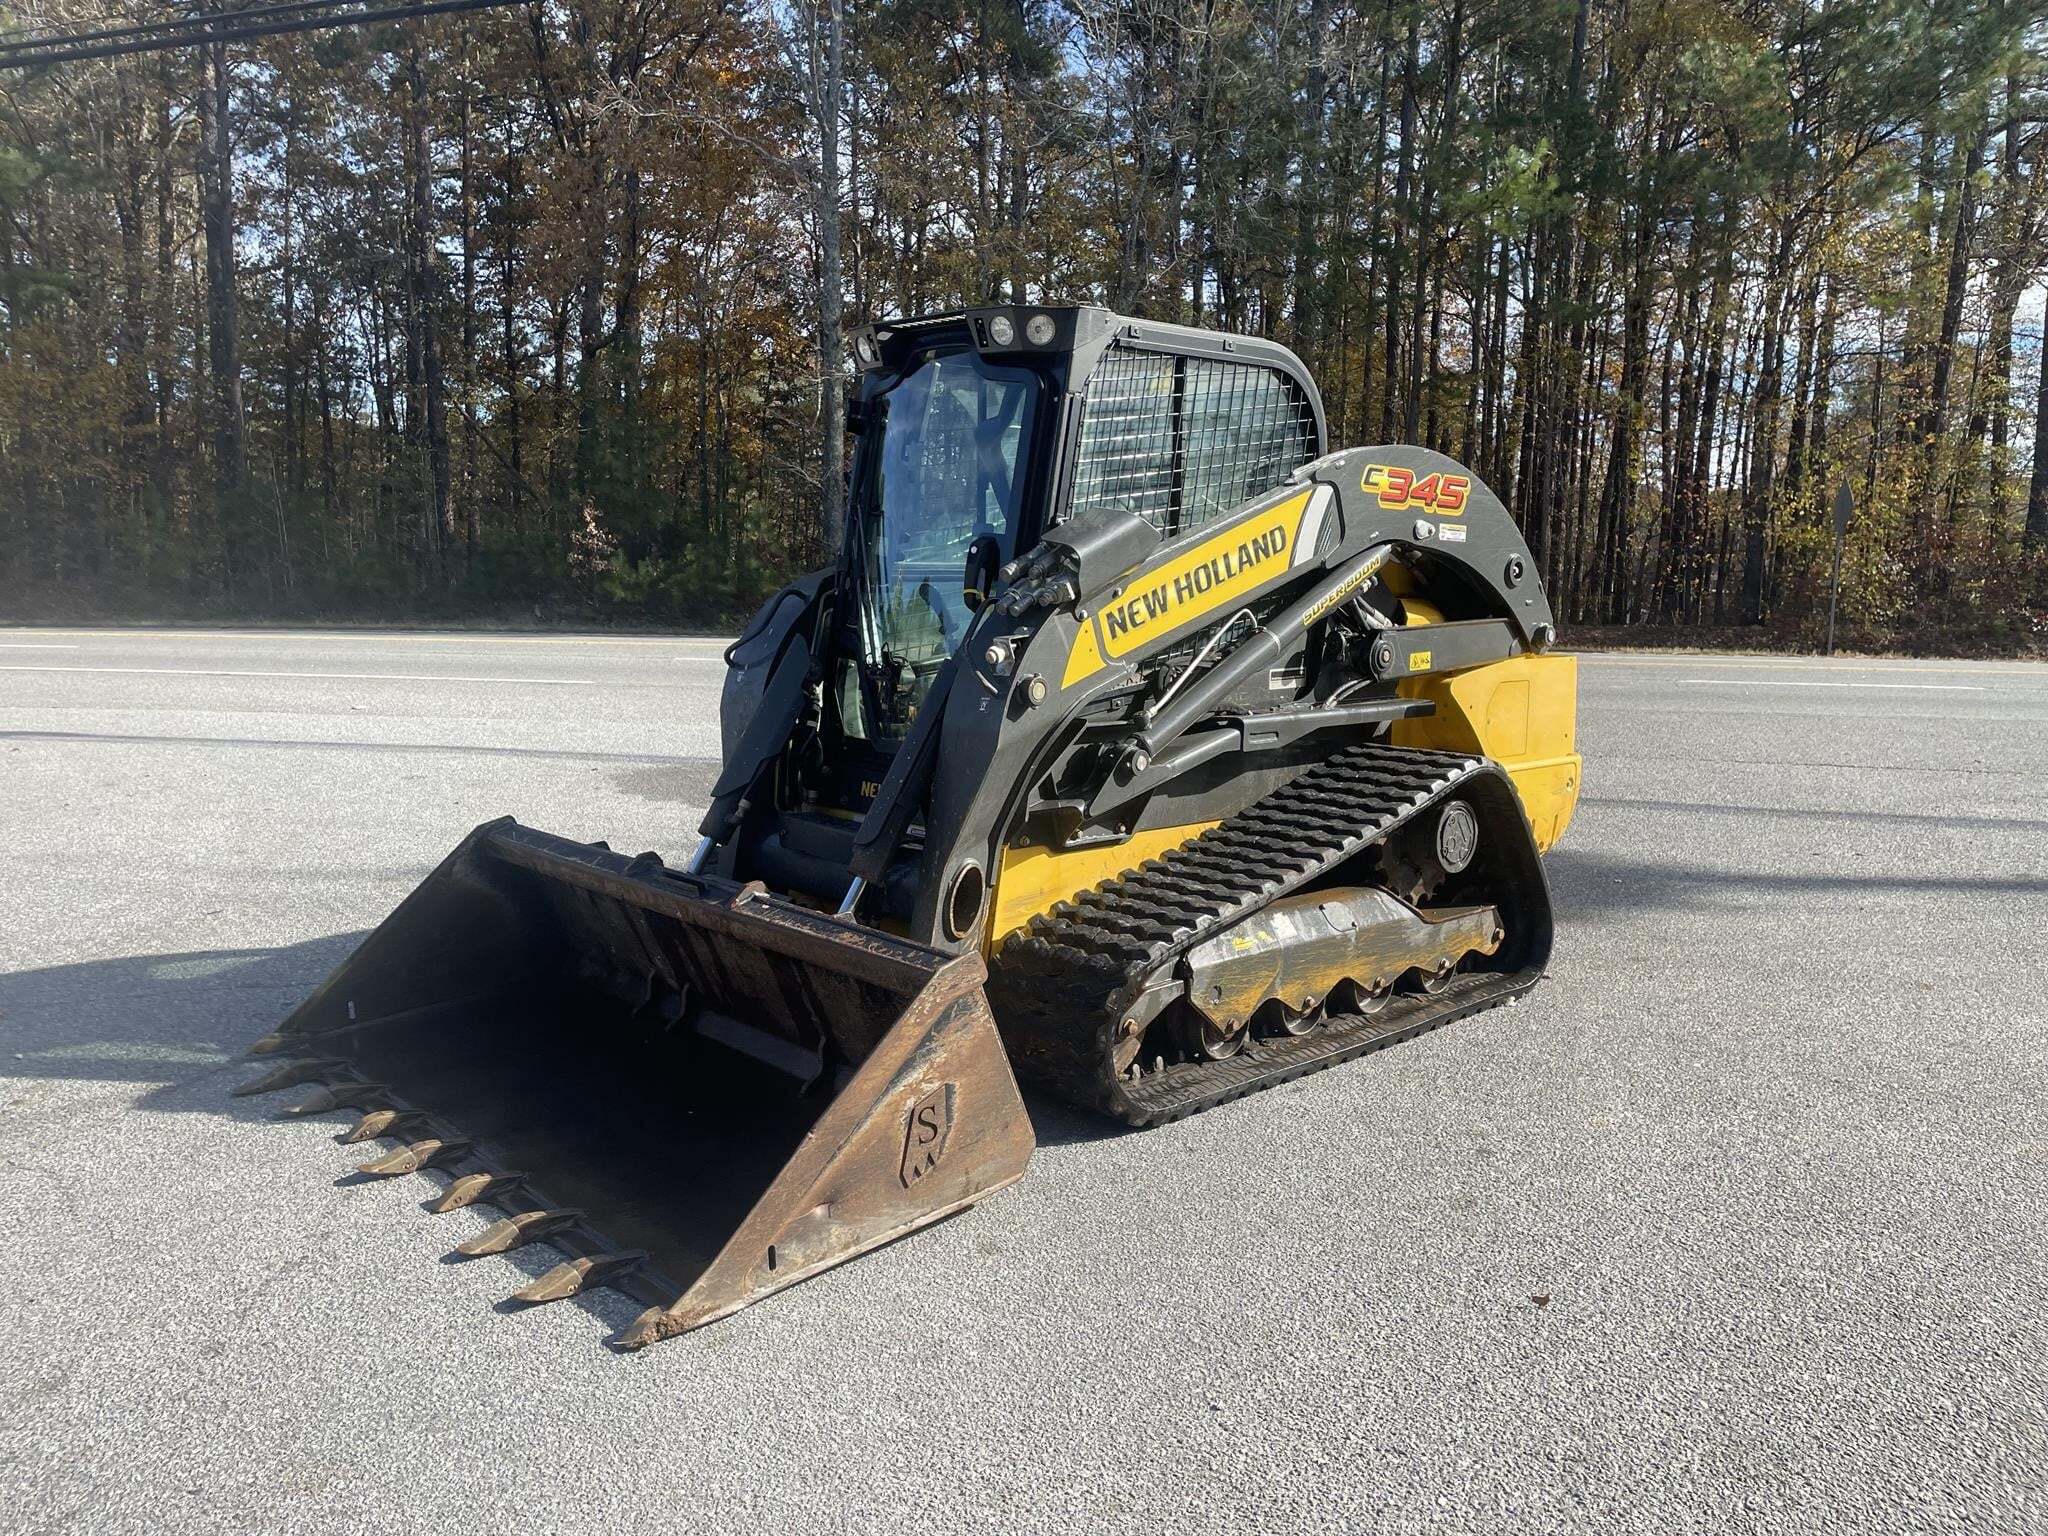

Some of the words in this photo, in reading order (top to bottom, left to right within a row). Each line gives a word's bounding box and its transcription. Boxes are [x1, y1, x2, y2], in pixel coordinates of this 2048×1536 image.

[1361, 464, 1471, 516] C345
[1105, 584, 1169, 640] NEW
[1173, 524, 1288, 605] HOLLAND
[861, 781, 881, 798] NE
[917, 1104, 938, 1146] S
